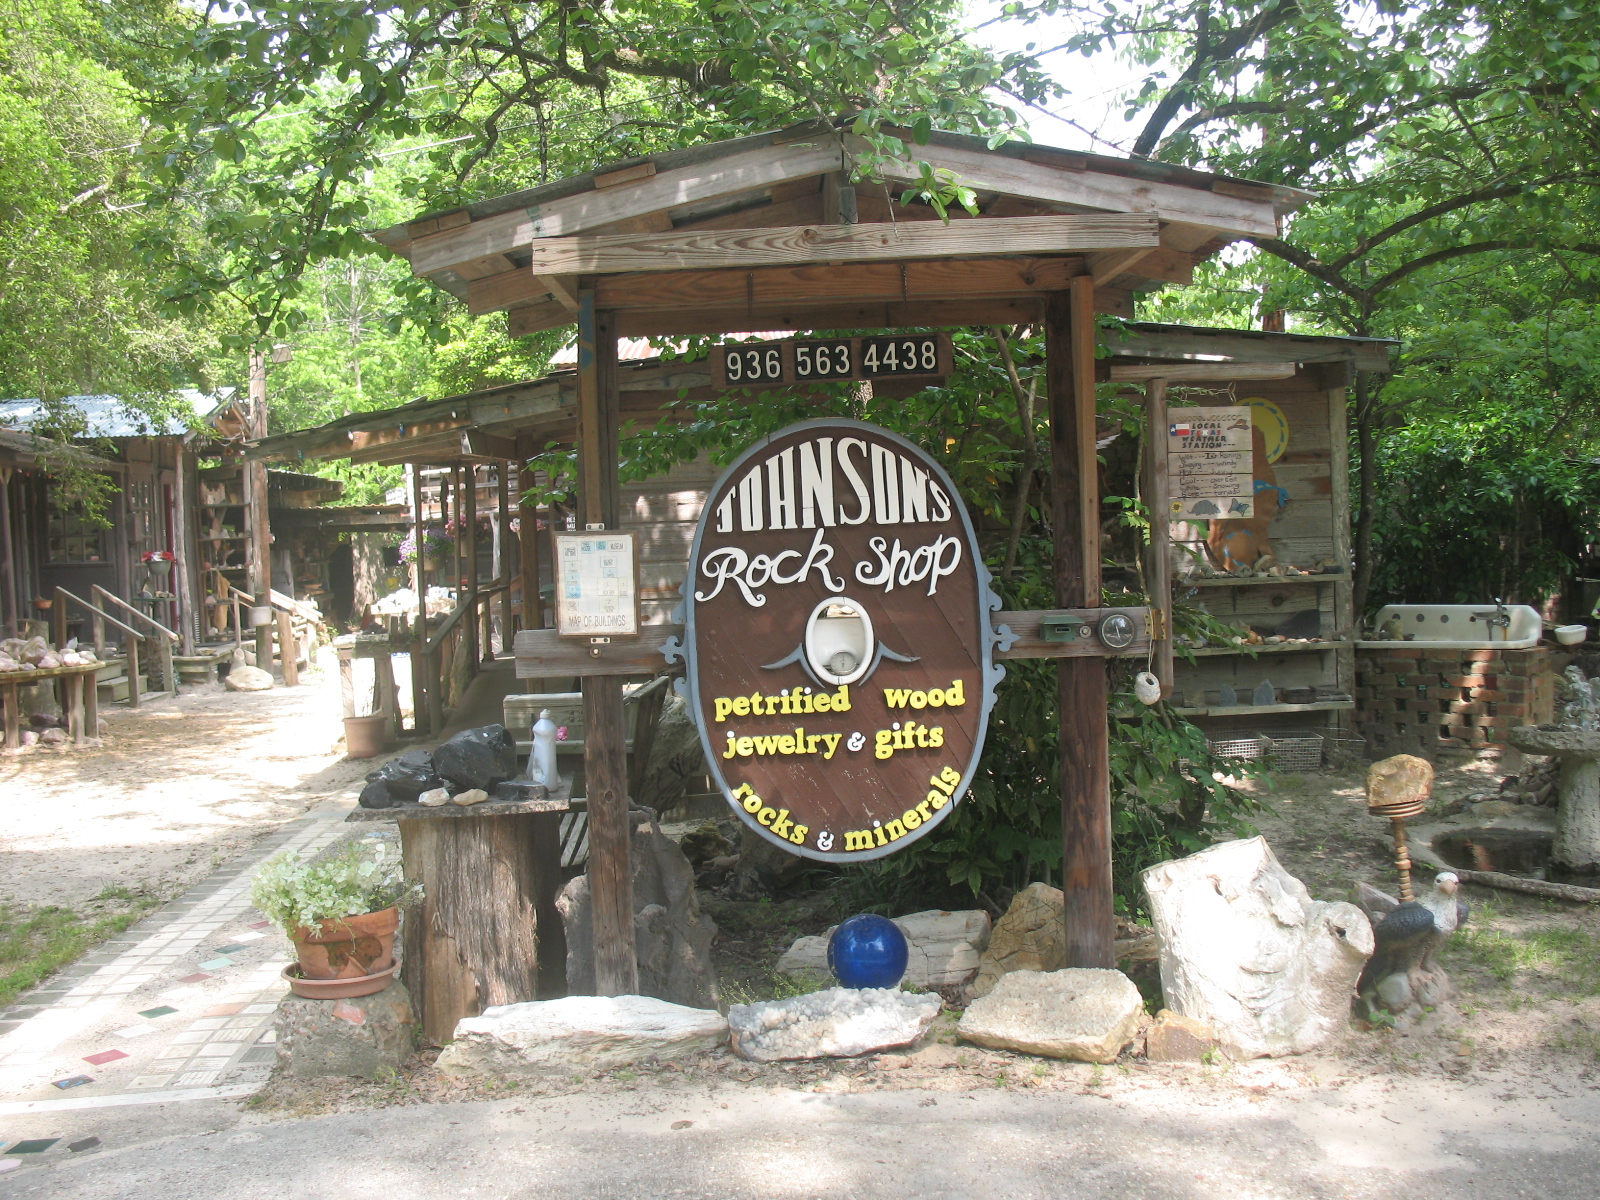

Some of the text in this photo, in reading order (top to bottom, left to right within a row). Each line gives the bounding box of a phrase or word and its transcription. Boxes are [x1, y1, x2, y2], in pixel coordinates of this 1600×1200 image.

[726, 341, 936, 381] 936 563 4438
[716, 437, 951, 533] JOHNSON'S
[695, 528, 962, 607] Rock Shop
[568, 615, 626, 627] MAP OF BUILDINGS
[714, 679, 965, 722] petrified wood
[723, 721, 944, 760] jewelry & gifts
[732, 766, 961, 851] rocks & minerals
